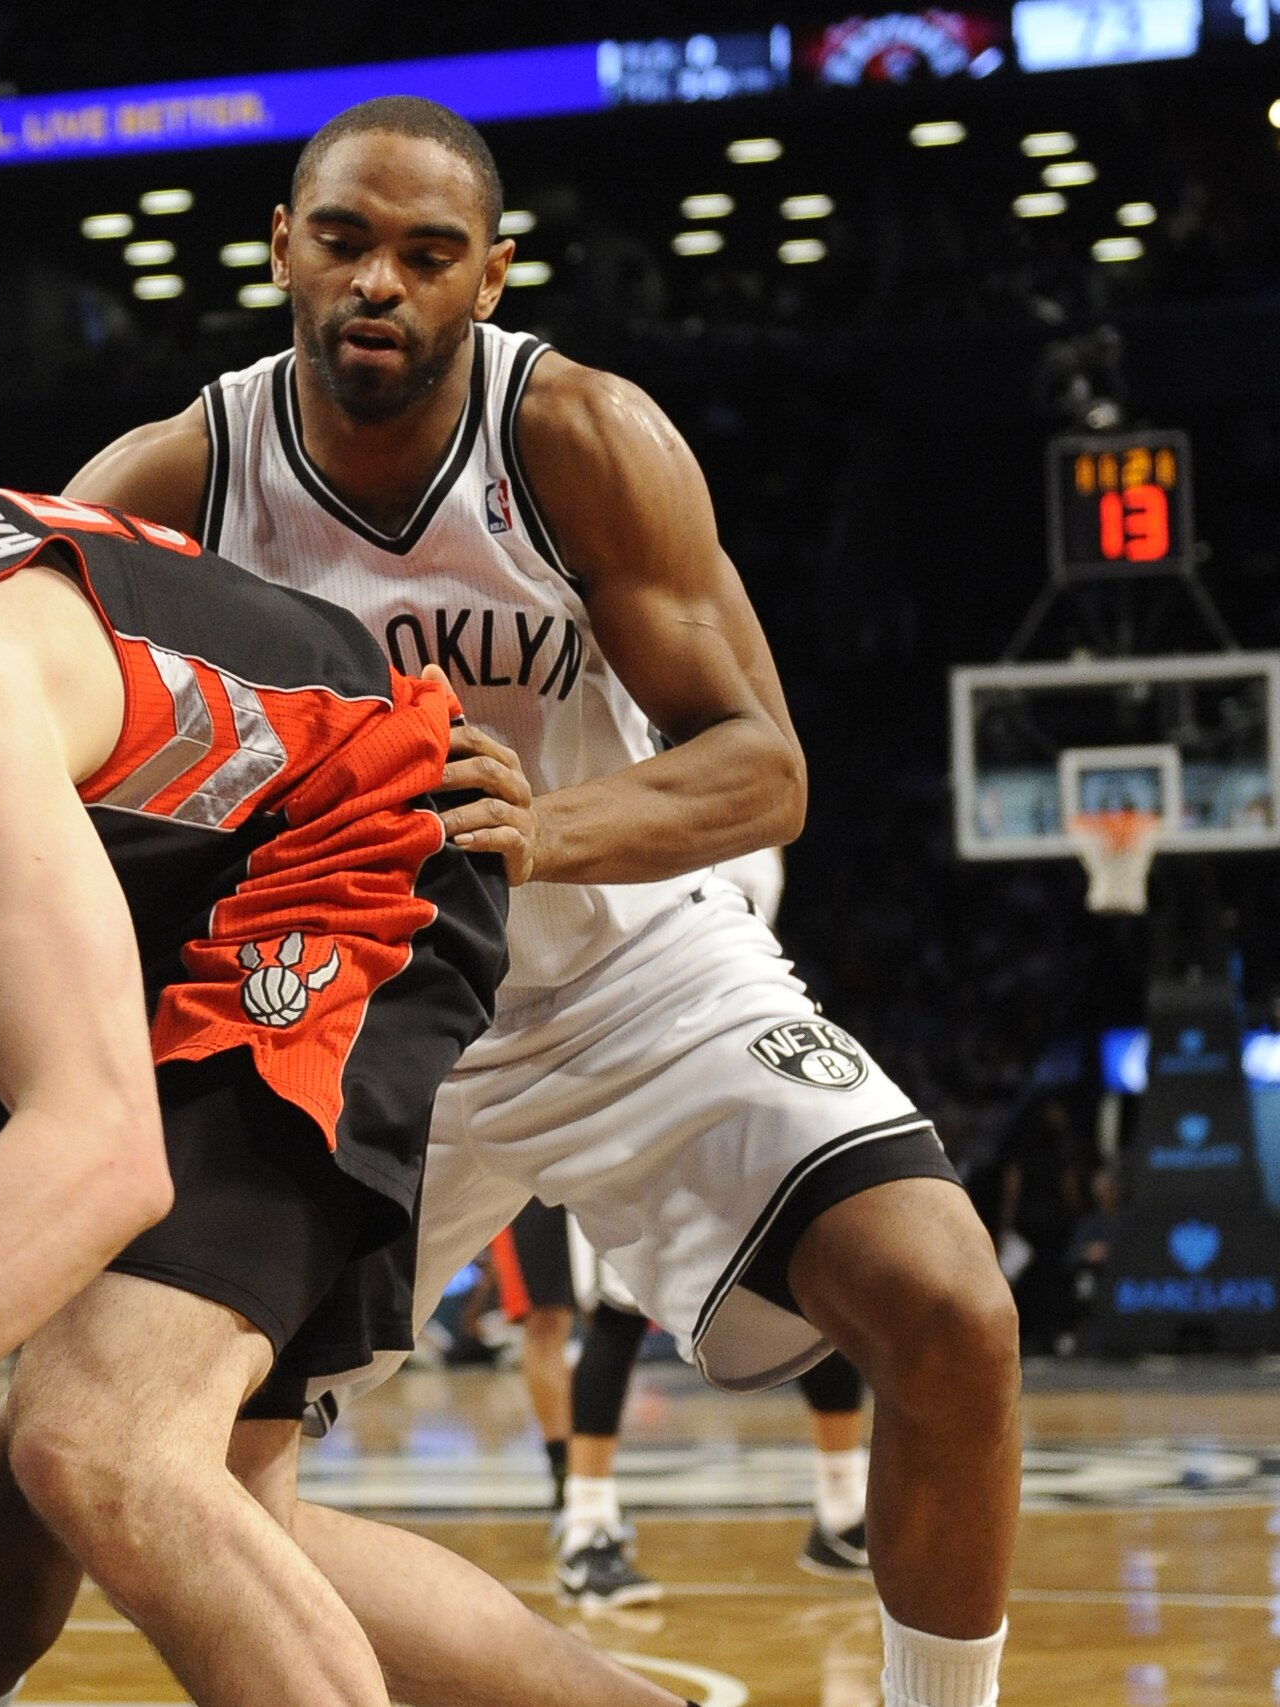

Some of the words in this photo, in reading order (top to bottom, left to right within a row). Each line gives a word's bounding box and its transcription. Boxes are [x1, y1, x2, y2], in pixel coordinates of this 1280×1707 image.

[21, 108, 107, 148] LIVE
[1099, 484, 1169, 562] 13
[759, 1023, 858, 1066] NETS
